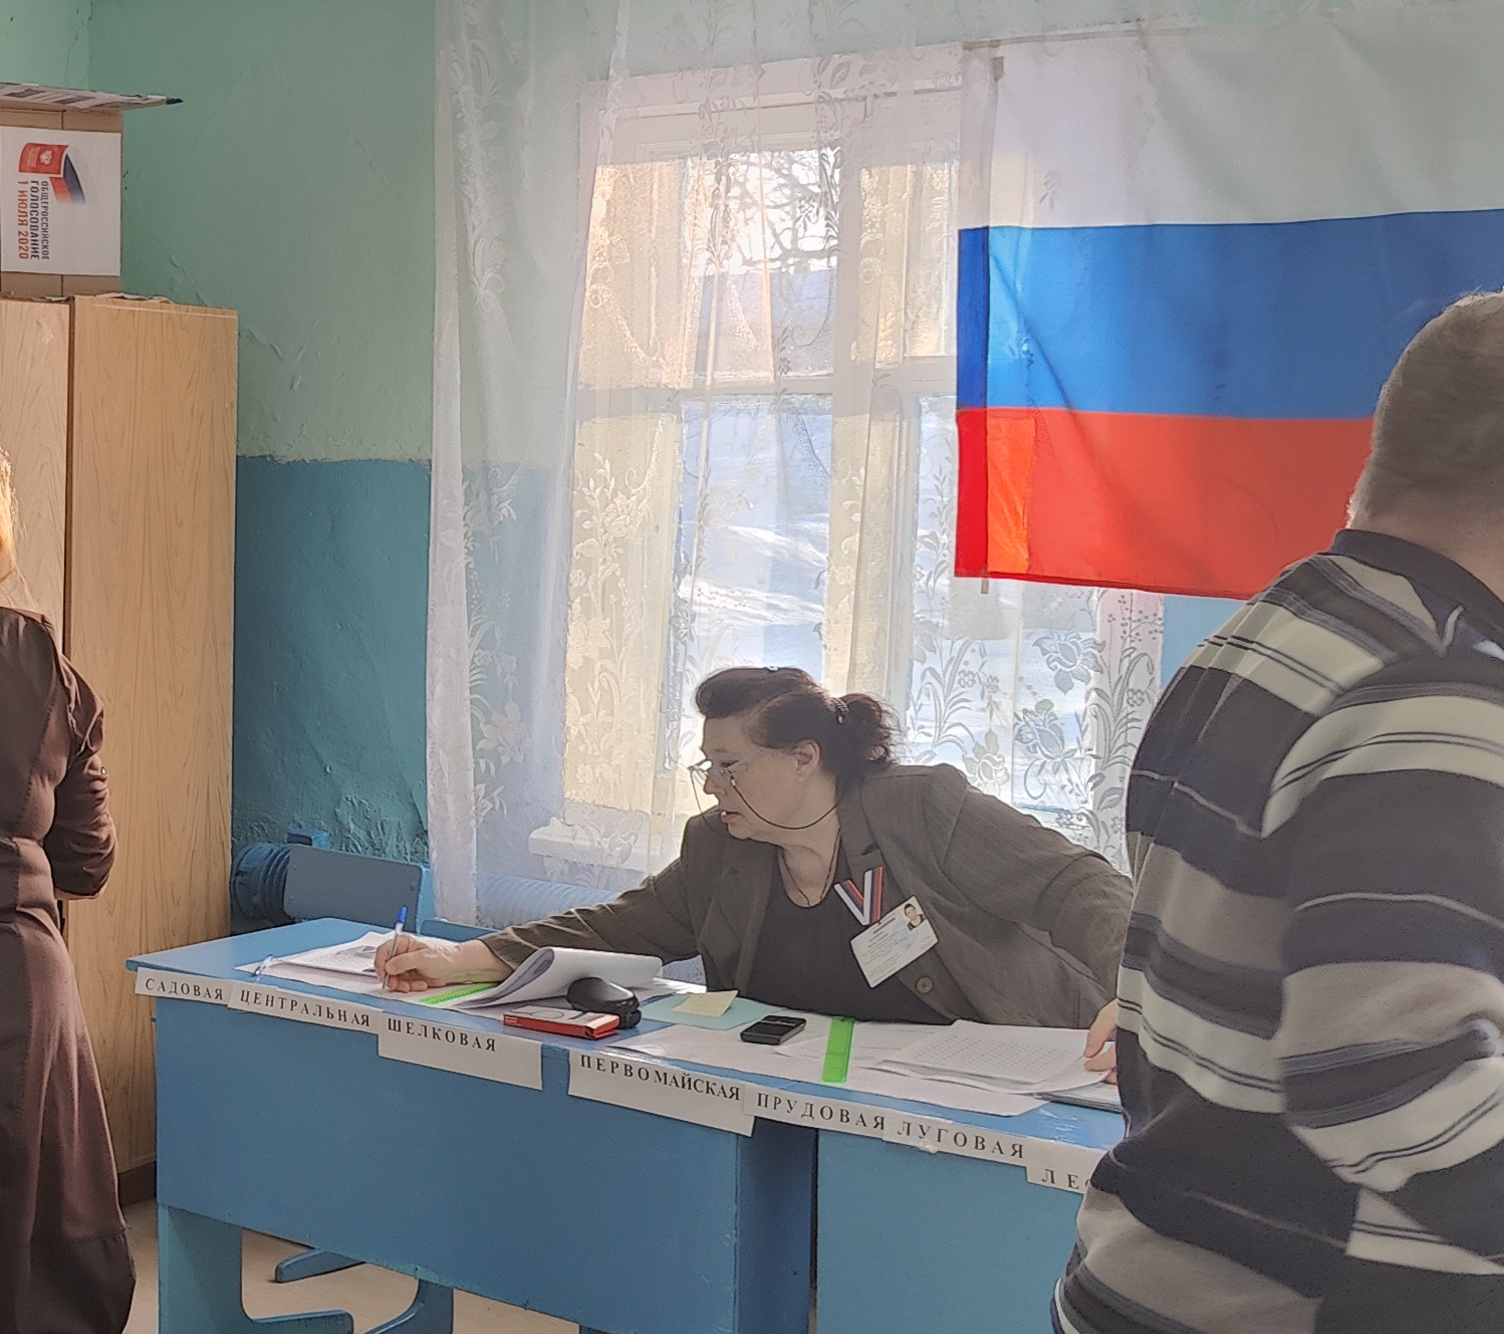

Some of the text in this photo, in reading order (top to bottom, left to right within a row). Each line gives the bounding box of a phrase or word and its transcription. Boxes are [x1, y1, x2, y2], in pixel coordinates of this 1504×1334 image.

[17, 190, 29, 227] ИЮЛЯ
[29, 180, 40, 261] ГОЛОСОВАНИЕ
[40, 180, 50, 261] ОБЩЕРОССИЙСКОЕ
[17, 230, 29, 260] 2020
[145, 977, 224, 1001] САДОВАЯ
[239, 989, 371, 1028] ЦЕНТРАЛЬНАЯ
[387, 1017, 497, 1053] ШЕЛКОВАЯ
[579, 1053, 741, 1102] ПЕРВОМАЙСКАЯ
[756, 1091, 886, 1132] ПРУДОВАЯ
[896, 1120, 1025, 1159] ЛУГОВАЯ
[1040, 1168, 1090, 1190] ЛЕ
